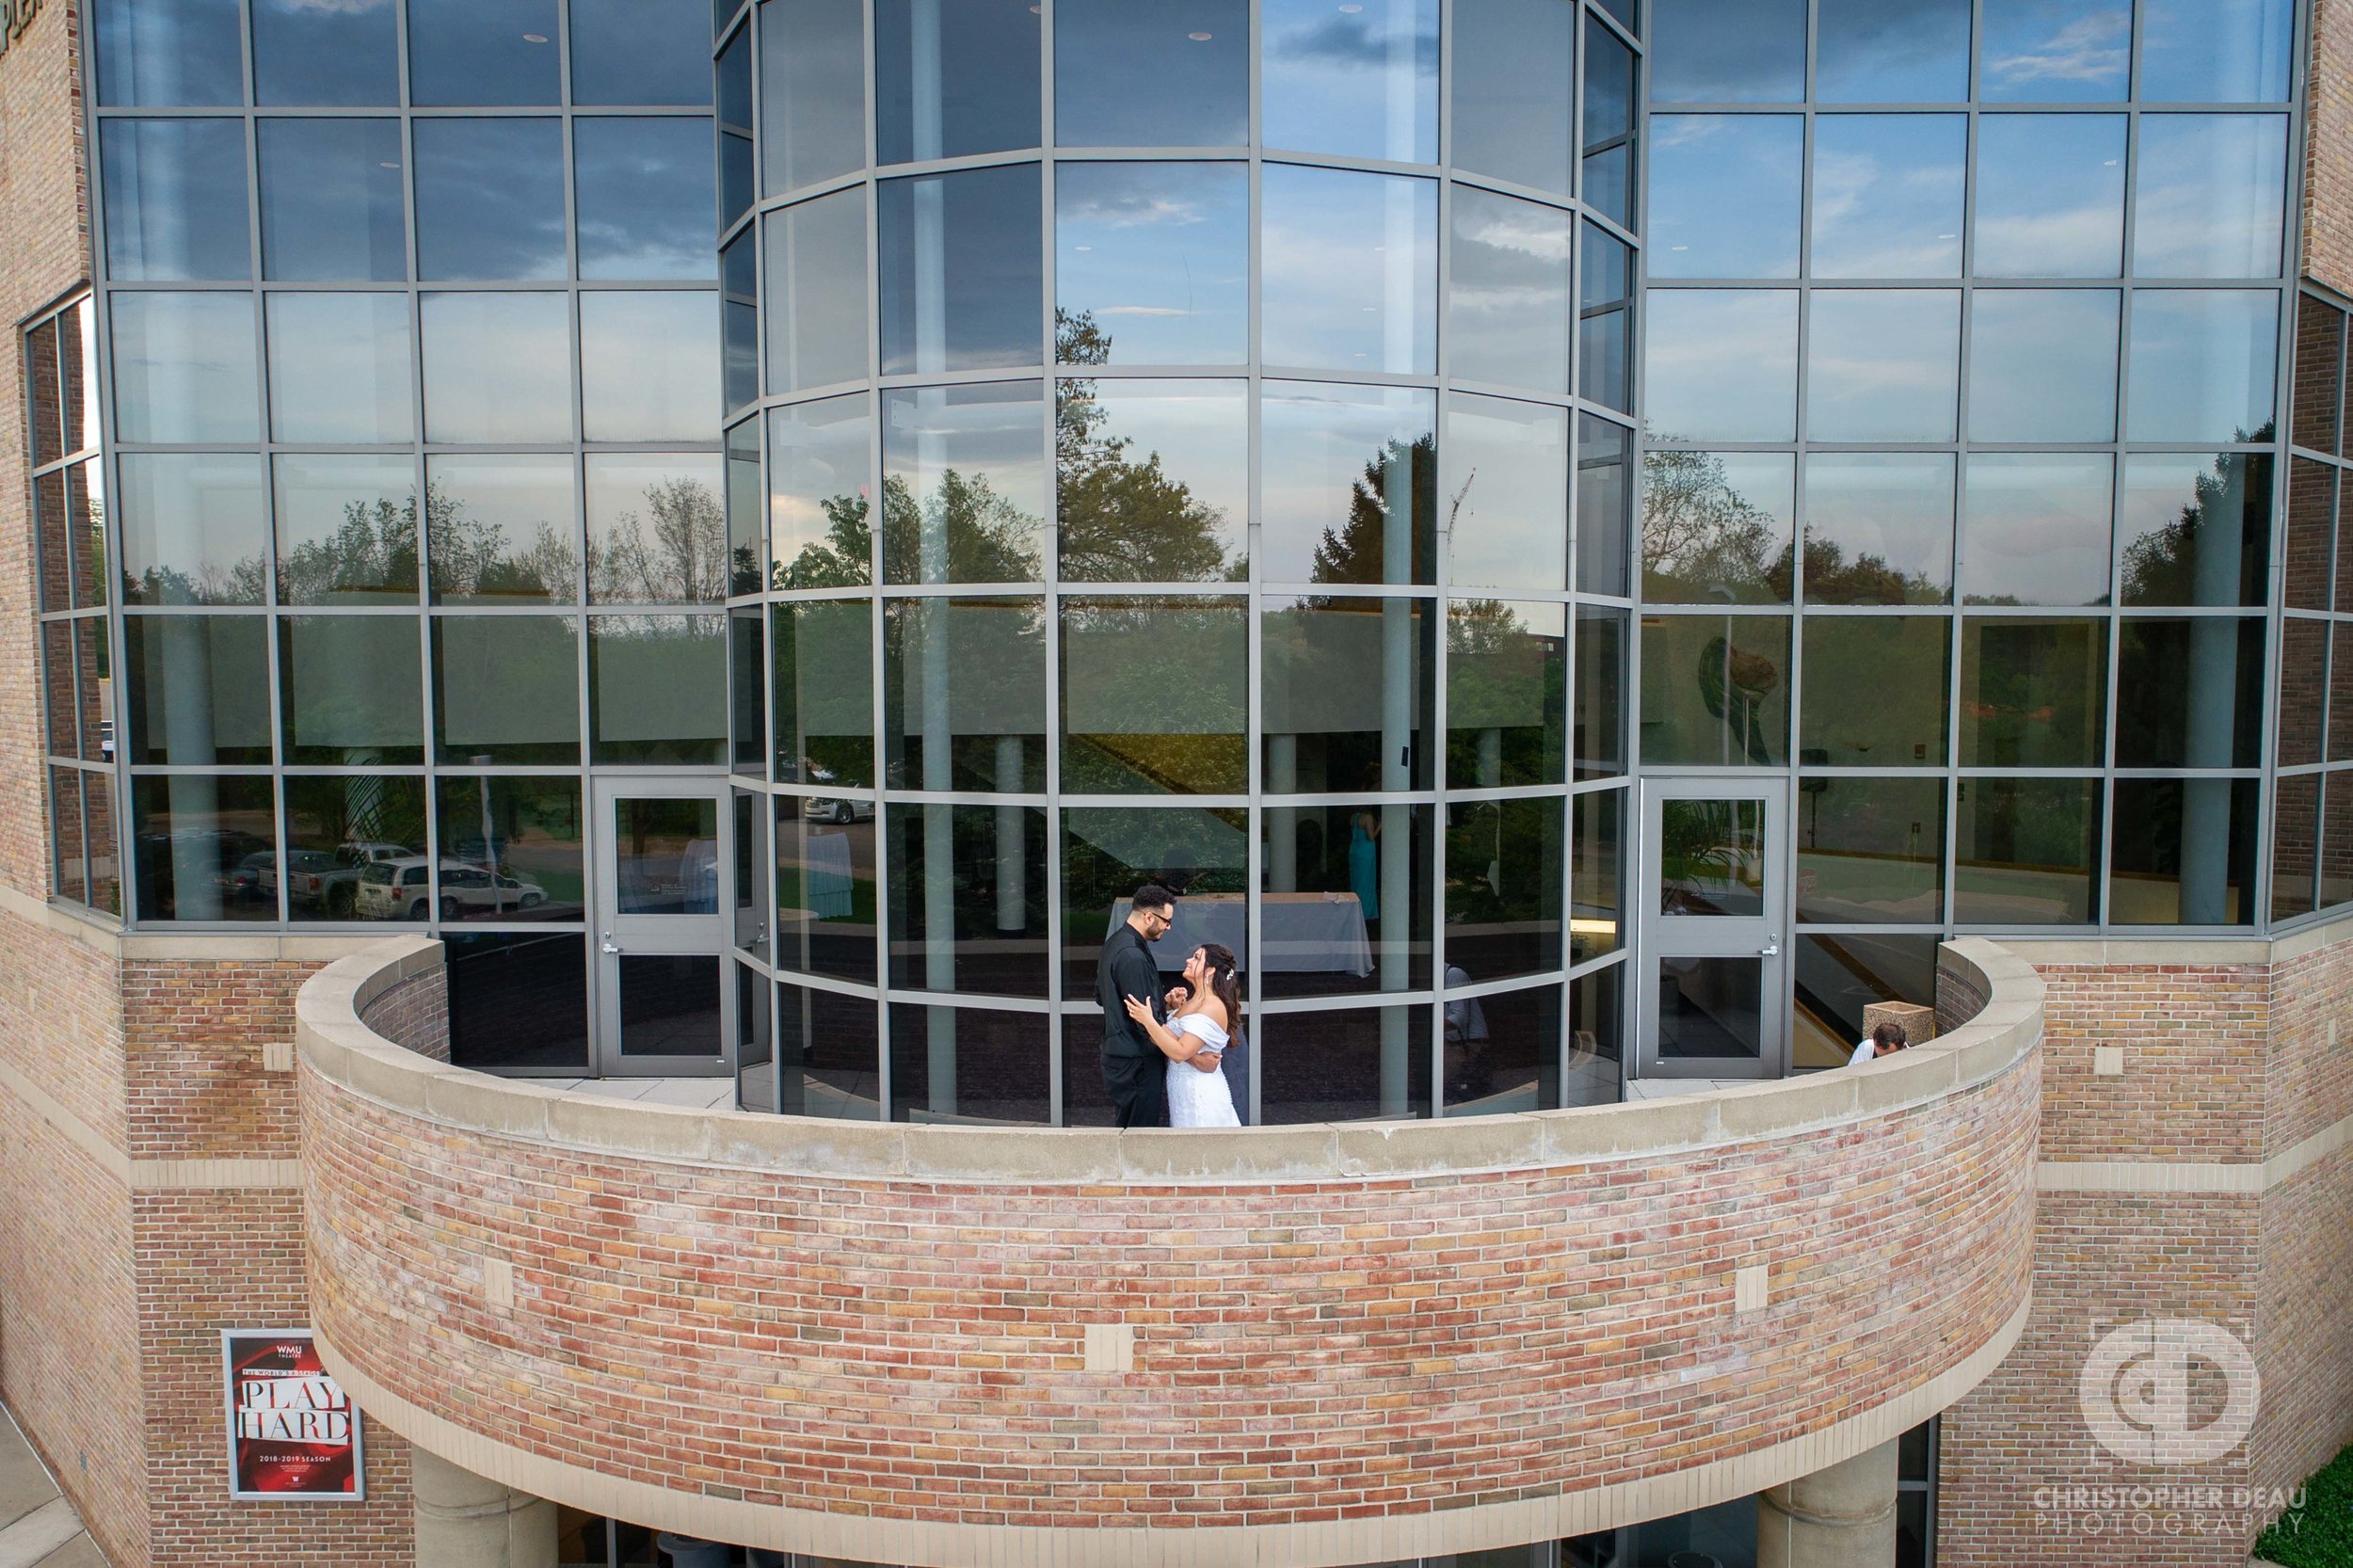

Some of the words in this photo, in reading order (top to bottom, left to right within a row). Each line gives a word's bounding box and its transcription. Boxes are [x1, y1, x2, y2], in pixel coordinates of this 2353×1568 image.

[276, 1345, 302, 1354] WMU
[243, 1381, 340, 1409] PLAY
[240, 1412, 349, 1440] HARD
